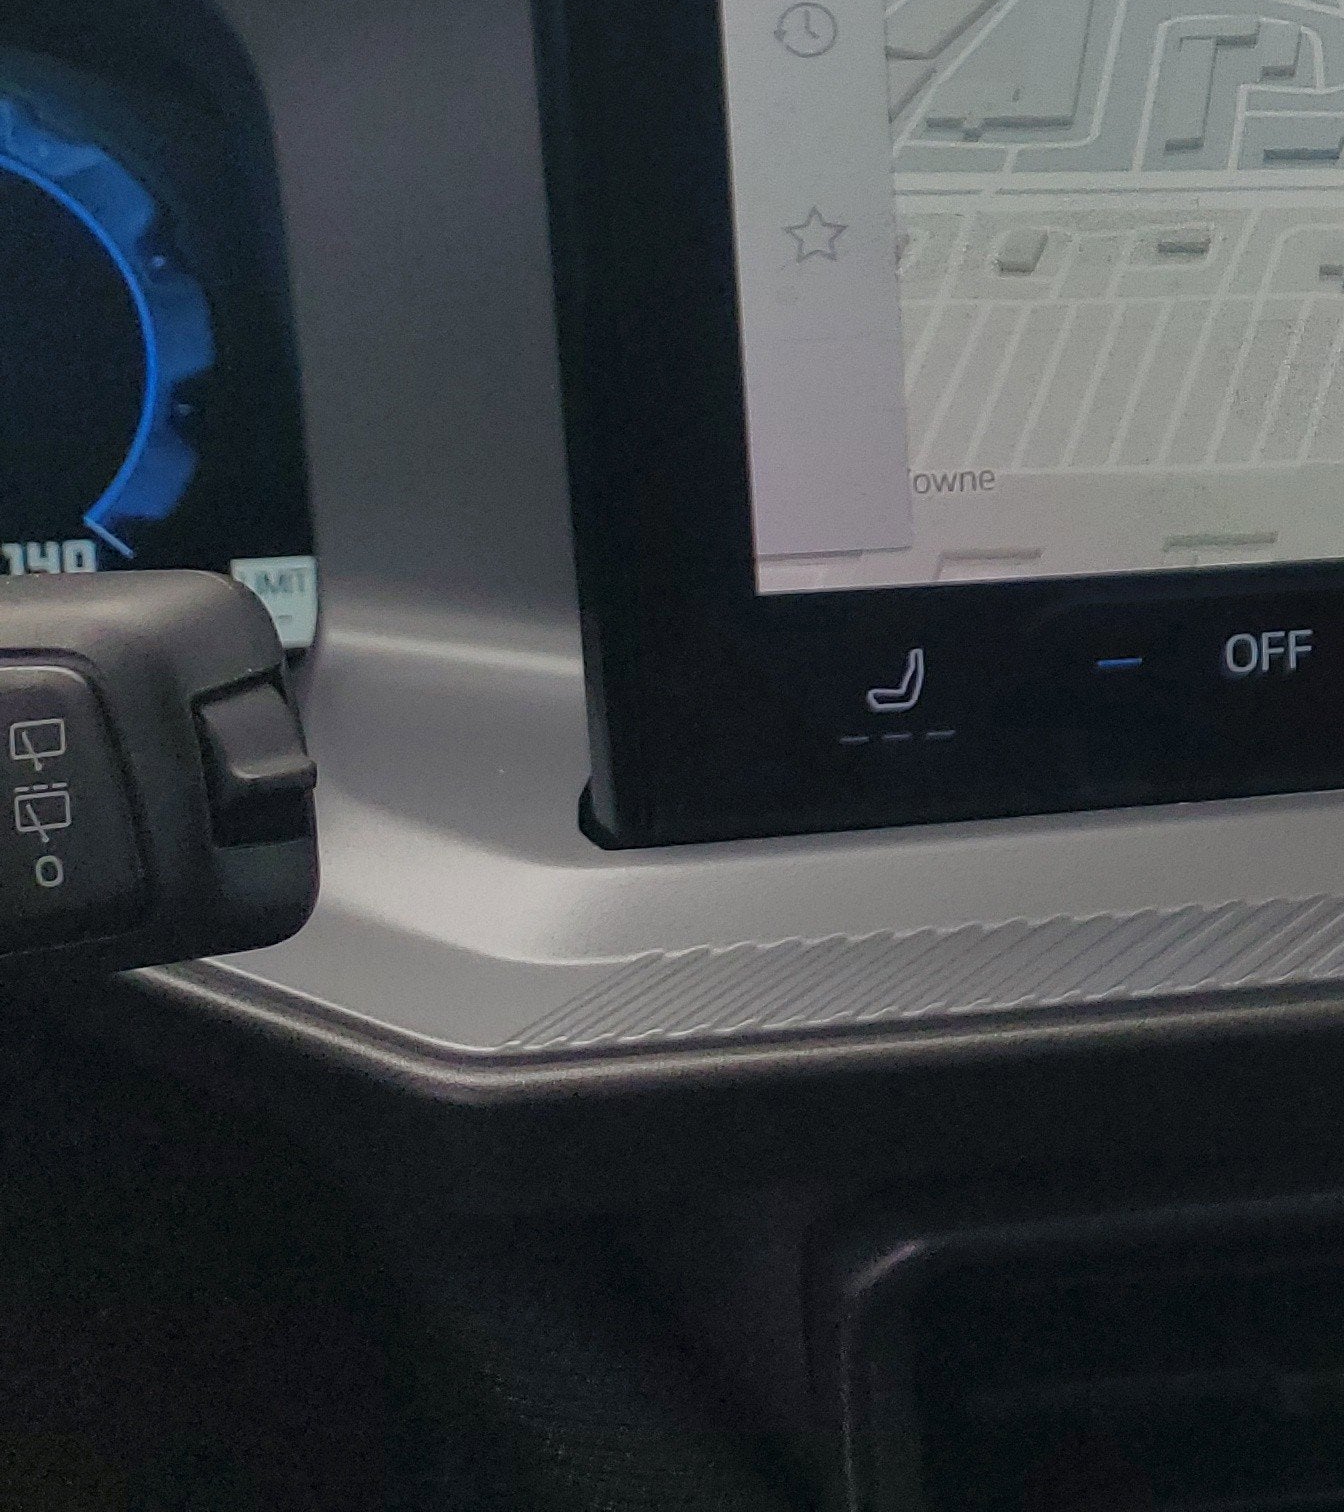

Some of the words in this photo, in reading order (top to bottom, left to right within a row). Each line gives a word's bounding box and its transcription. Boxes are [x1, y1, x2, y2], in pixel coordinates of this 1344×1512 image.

[906, 468, 995, 494] owne
[0, 539, 97, 576] 140
[1226, 629, 1313, 672] OFF
